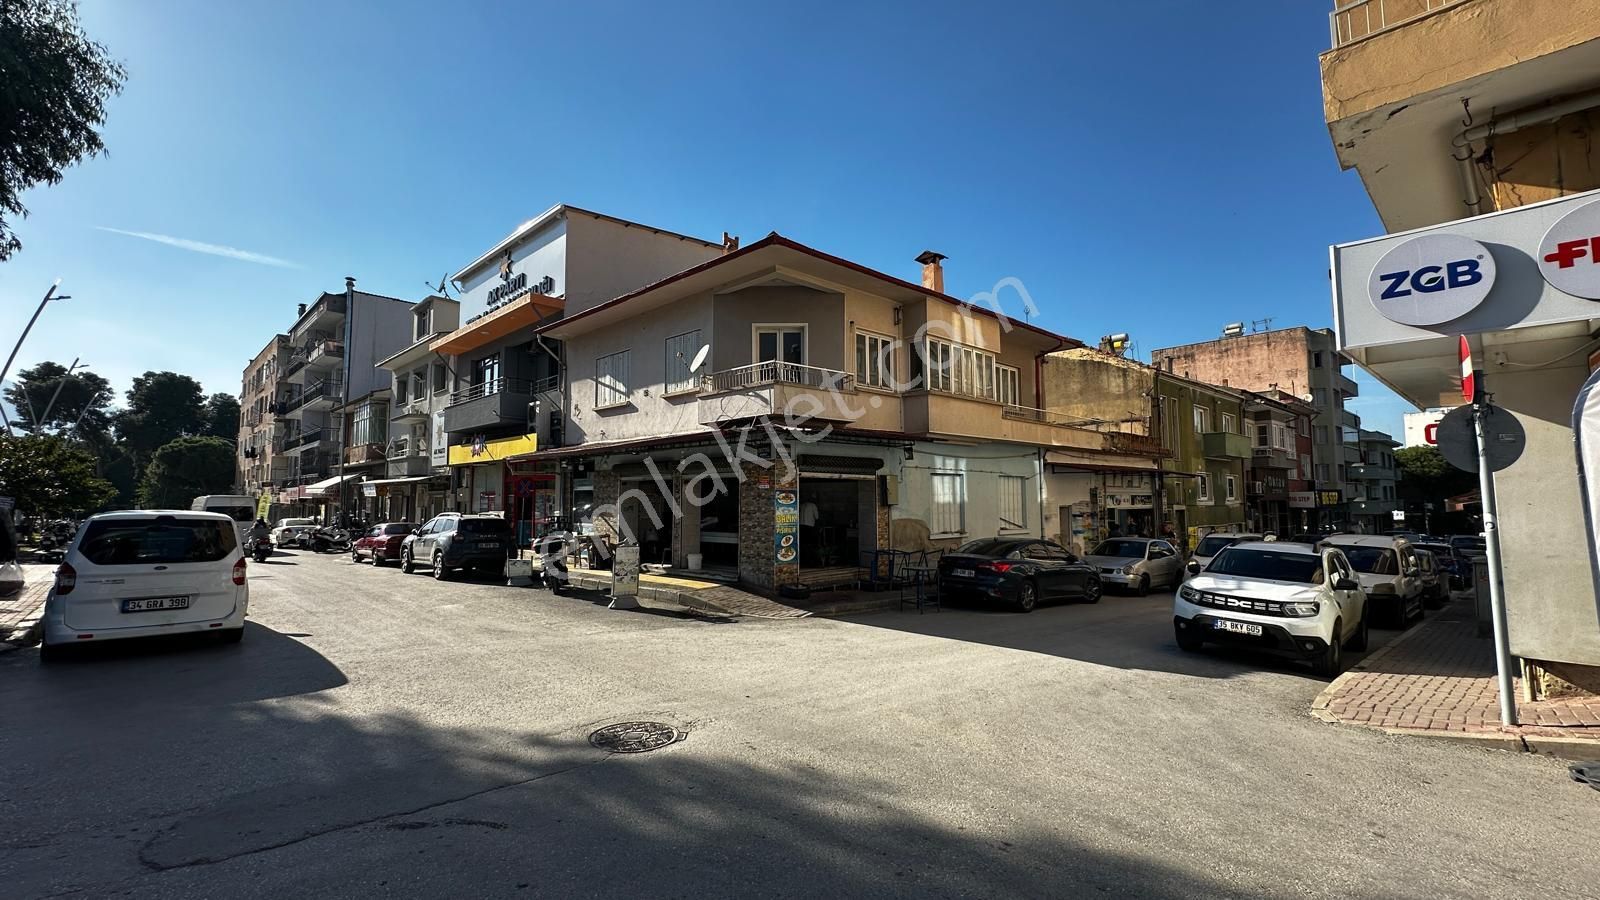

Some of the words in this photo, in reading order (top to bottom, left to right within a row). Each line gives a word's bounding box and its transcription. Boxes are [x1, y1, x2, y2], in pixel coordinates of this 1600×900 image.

[1379, 258, 1483, 300] ZGB
[486, 286, 500, 306] AK
[129, 601, 142, 610] 34
[146, 600, 164, 609] GRA
[168, 598, 186, 608] 398
[1218, 620, 1227, 628] 35
[1230, 622, 1244, 630] BKY
[1246, 625, 1260, 633] 605
